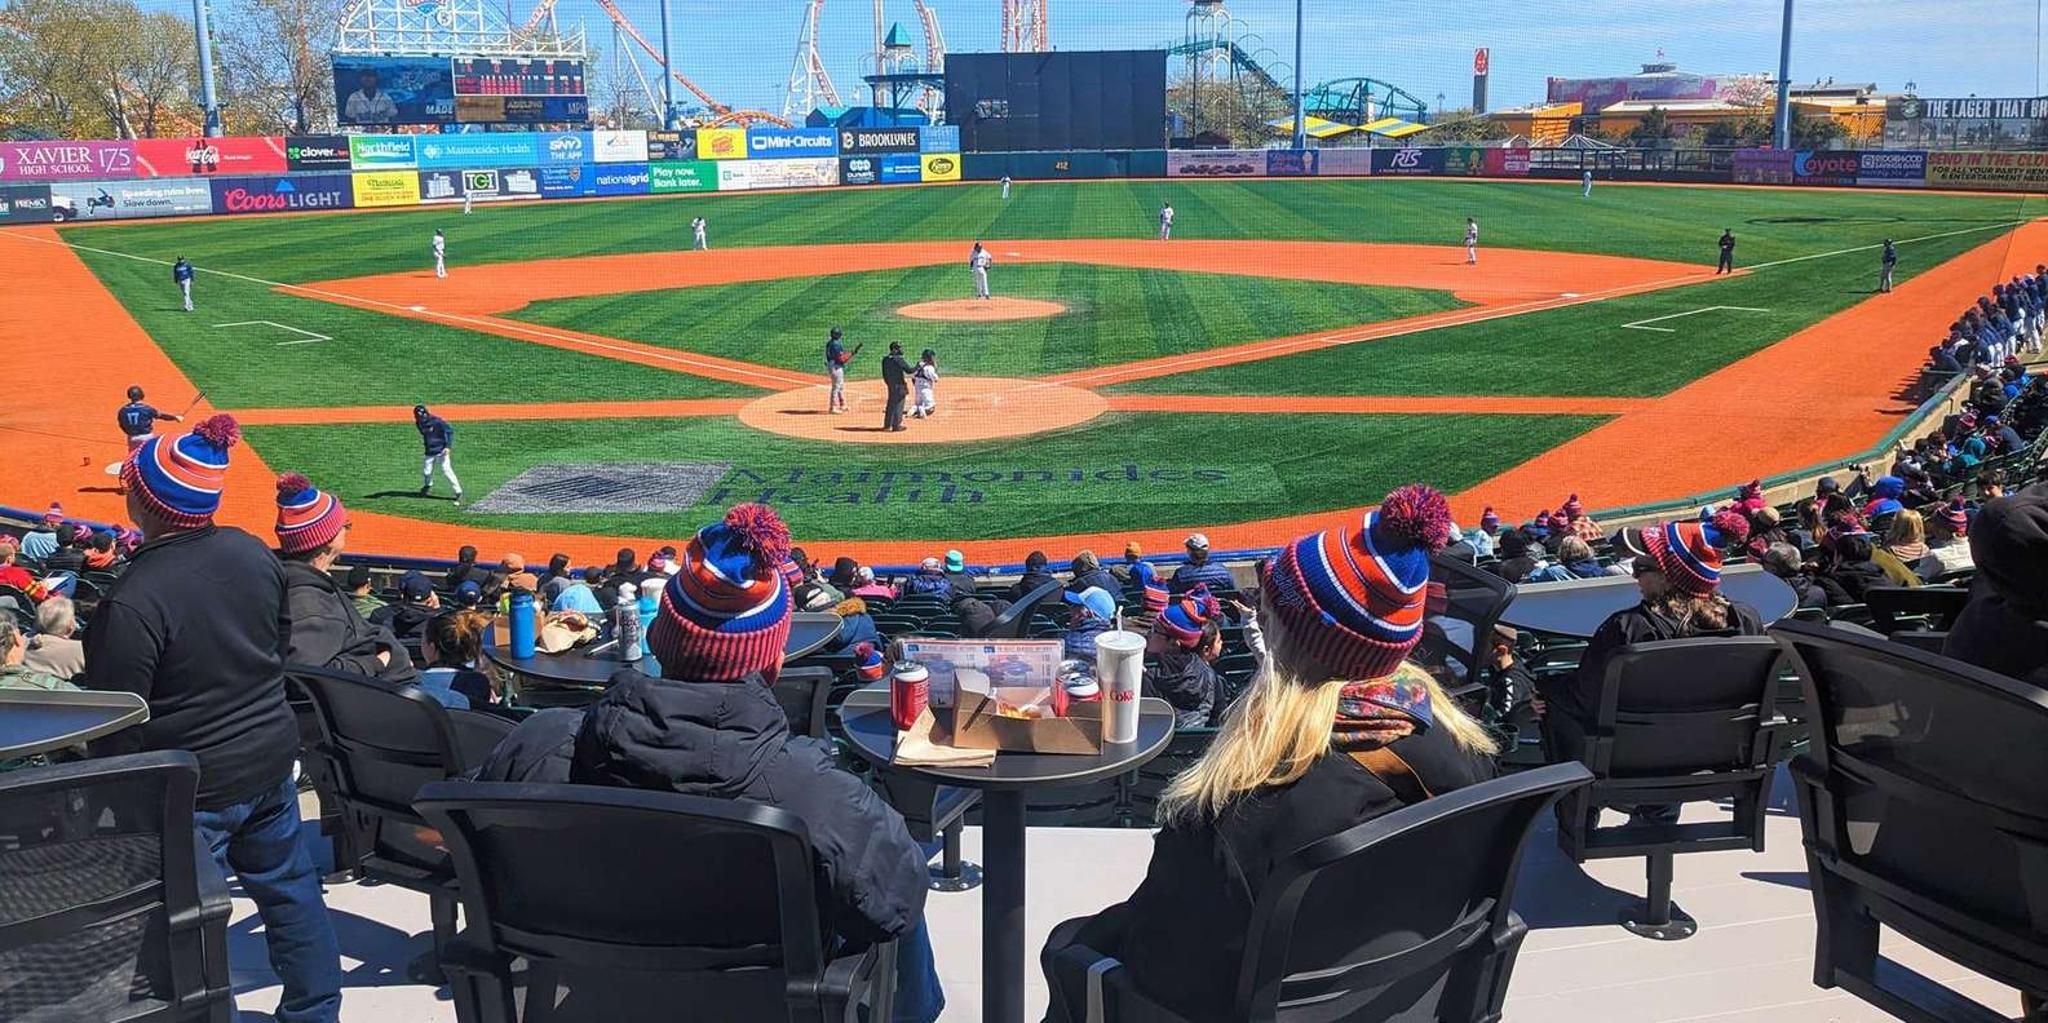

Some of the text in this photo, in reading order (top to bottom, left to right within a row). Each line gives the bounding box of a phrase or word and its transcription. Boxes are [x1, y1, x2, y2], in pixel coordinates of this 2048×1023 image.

[1926, 100, 1949, 118] THE
[1952, 100, 1991, 118] LAGER
[1995, 100, 2028, 118] THAT
[357, 142, 410, 153] Northfield
[549, 139, 579, 151] SNY
[768, 136, 833, 147] Mini-Circuits
[17, 147, 93, 165] XAVIER
[300, 147, 334, 157] clover
[1390, 149, 1422, 167] RTS
[99, 148, 131, 173] 175
[1928, 153, 1962, 166] SEND
[1986, 153, 2013, 166] THE
[20, 163, 93, 175] HIGH SCHOOL
[596, 172, 649, 186] nationalgrid
[653, 178, 679, 187] Bank
[225, 188, 286, 211] Coors
[289, 192, 341, 208] LIGHT
[127, 412, 140, 425] 17
